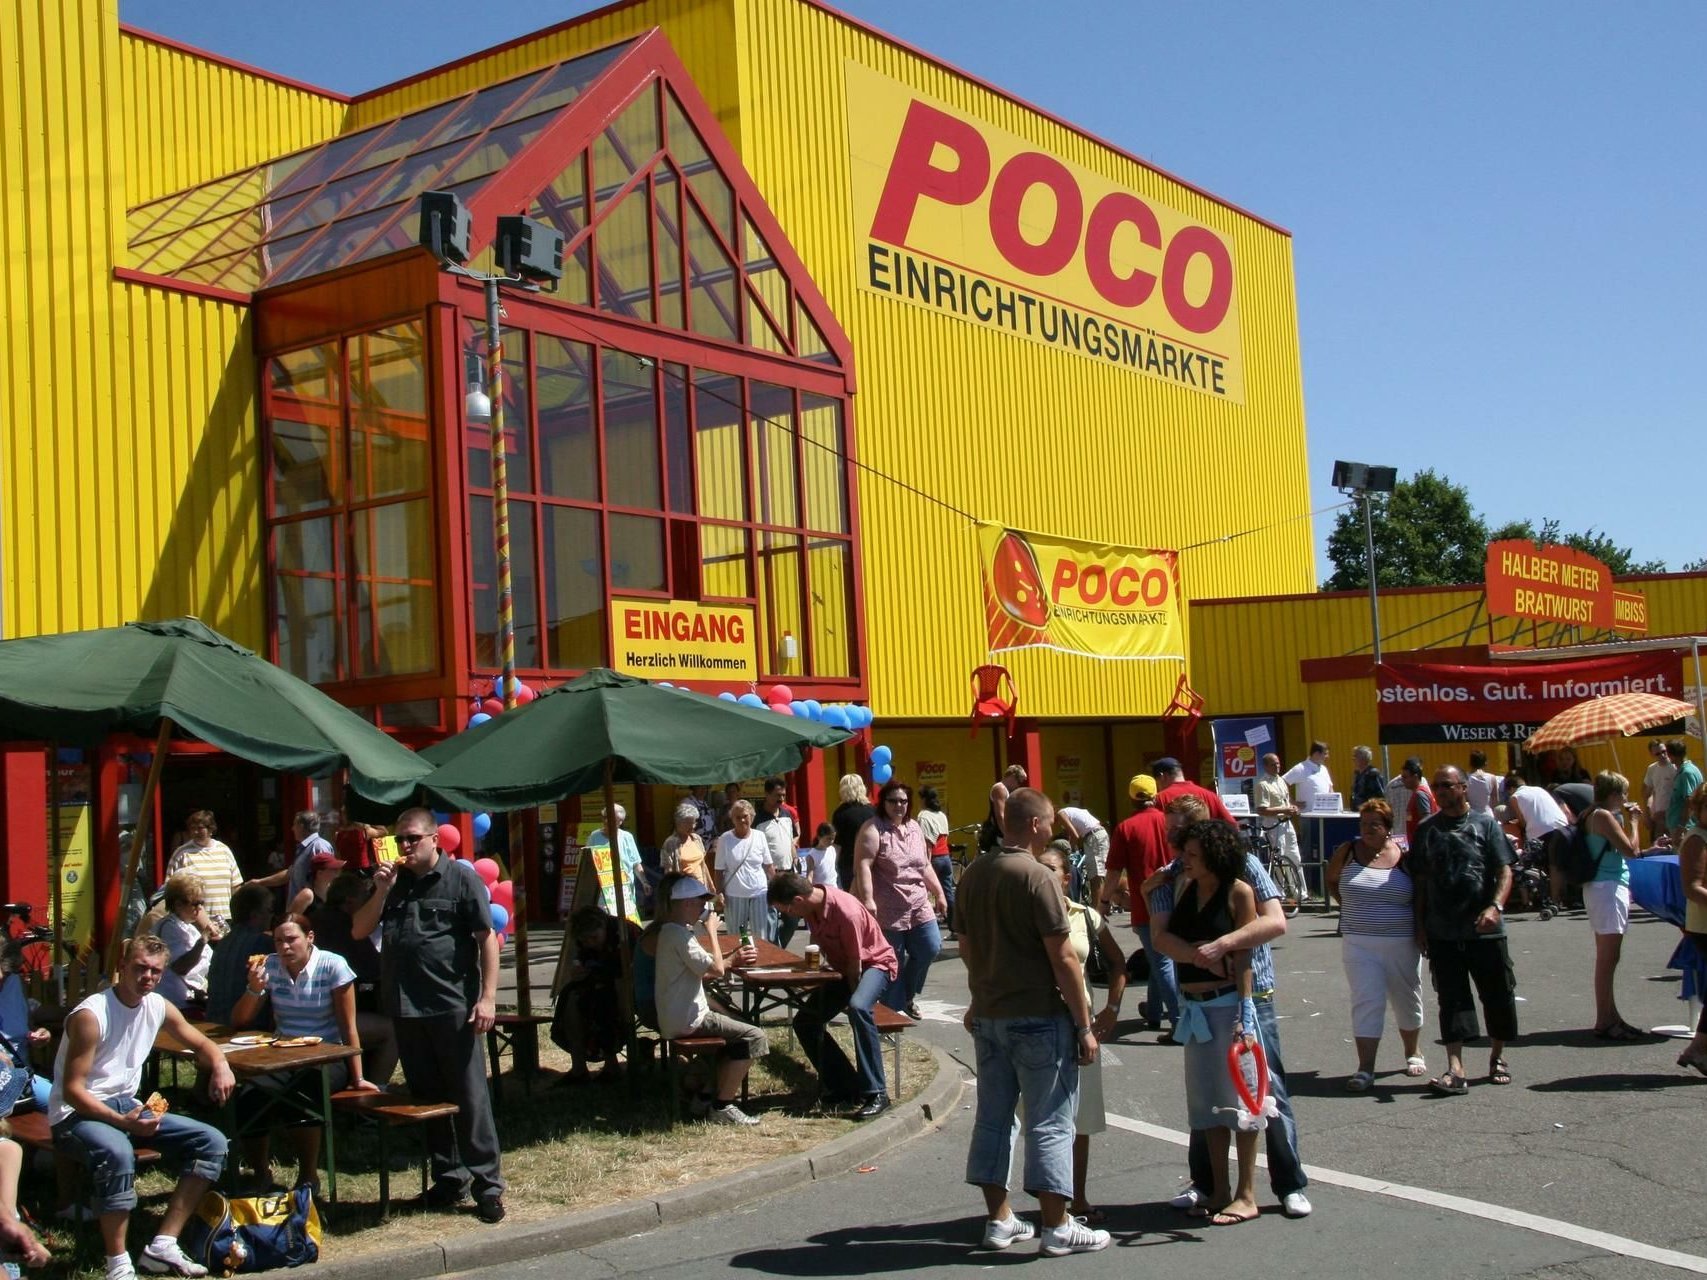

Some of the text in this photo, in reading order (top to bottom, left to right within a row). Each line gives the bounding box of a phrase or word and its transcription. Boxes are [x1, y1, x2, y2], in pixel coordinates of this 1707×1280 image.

[868, 97, 1233, 334] POCO
[868, 243, 1226, 395] EINRICHTUNGSMÄRKTE
[1051, 558, 1168, 607] POCO
[1502, 551, 1599, 593] HALBER METER
[1515, 588, 1594, 623] BRATWURST
[1615, 599, 1645, 623] IMBISS
[624, 608, 745, 644] EINGANG
[626, 651, 747, 670] Herzlich Willkommen
[1483, 682, 1533, 701] Gut.
[1542, 674, 1672, 699] Informiert.
